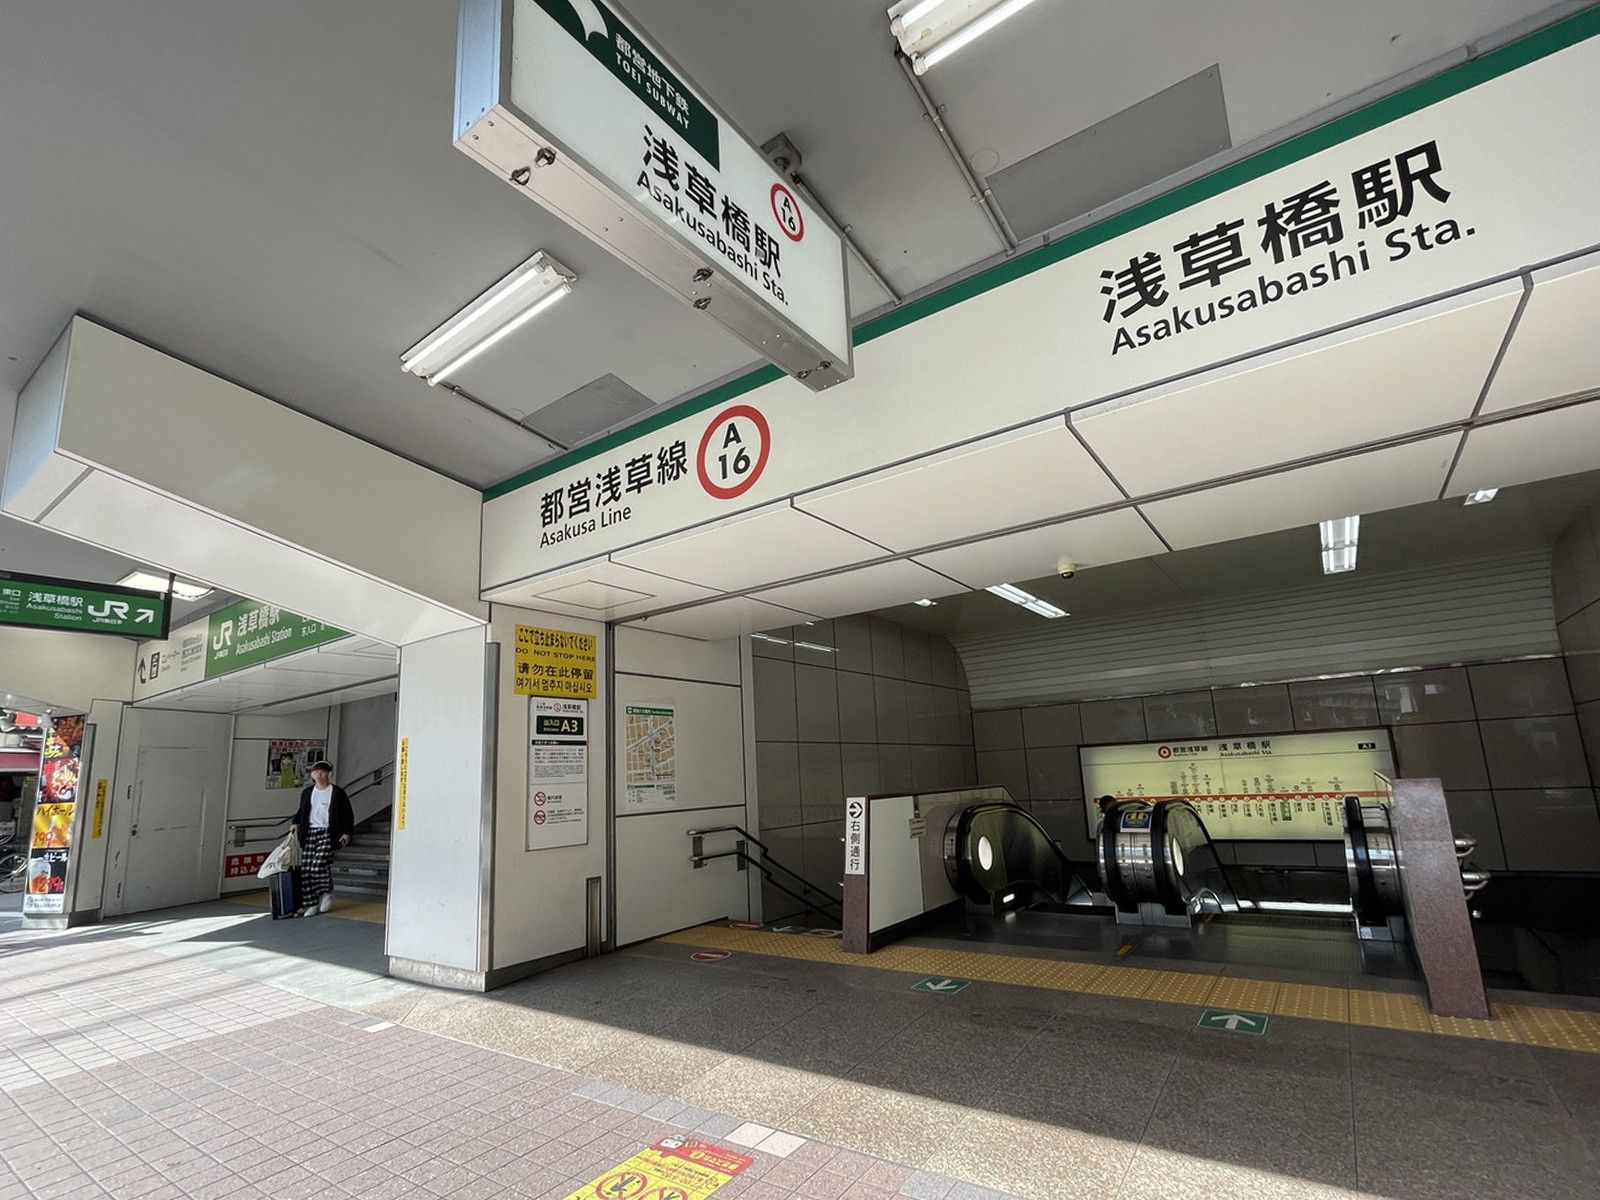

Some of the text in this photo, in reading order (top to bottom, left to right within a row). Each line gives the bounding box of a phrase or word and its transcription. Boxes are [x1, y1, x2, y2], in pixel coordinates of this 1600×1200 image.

[615, 32, 690, 116] 都営地下鉄
[615, 52, 689, 129] TOEI SUBWAY
[643, 124, 781, 278] 浅草橋駅
[783, 196, 793, 214] A
[781, 207, 797, 232] 16
[1099, 139, 1452, 324] 浅草橋駅
[636, 170, 790, 306] Asakusabashi Sta.
[1111, 218, 1476, 356] Asakusabashi Sta.
[722, 422, 742, 450] A
[718, 447, 751, 480] 16
[540, 440, 688, 529] 都営浅草線
[539, 506, 632, 549] Asakusa Line
[26, 602, 83, 615] Asakusabashi
[28, 591, 83, 607] 浅草橋駅
[87, 600, 130, 620] JR
[53, 612, 82, 622] Station
[212, 619, 233, 651] JR
[271, 625, 293, 644] Station
[515, 647, 596, 662] DO NOT STOP HERE
[516, 677, 540, 691] 여기서
[518, 662, 594, 680] 请勿在此停留
[560, 719, 579, 733] A3
[849, 820, 861, 871] 右側通行
